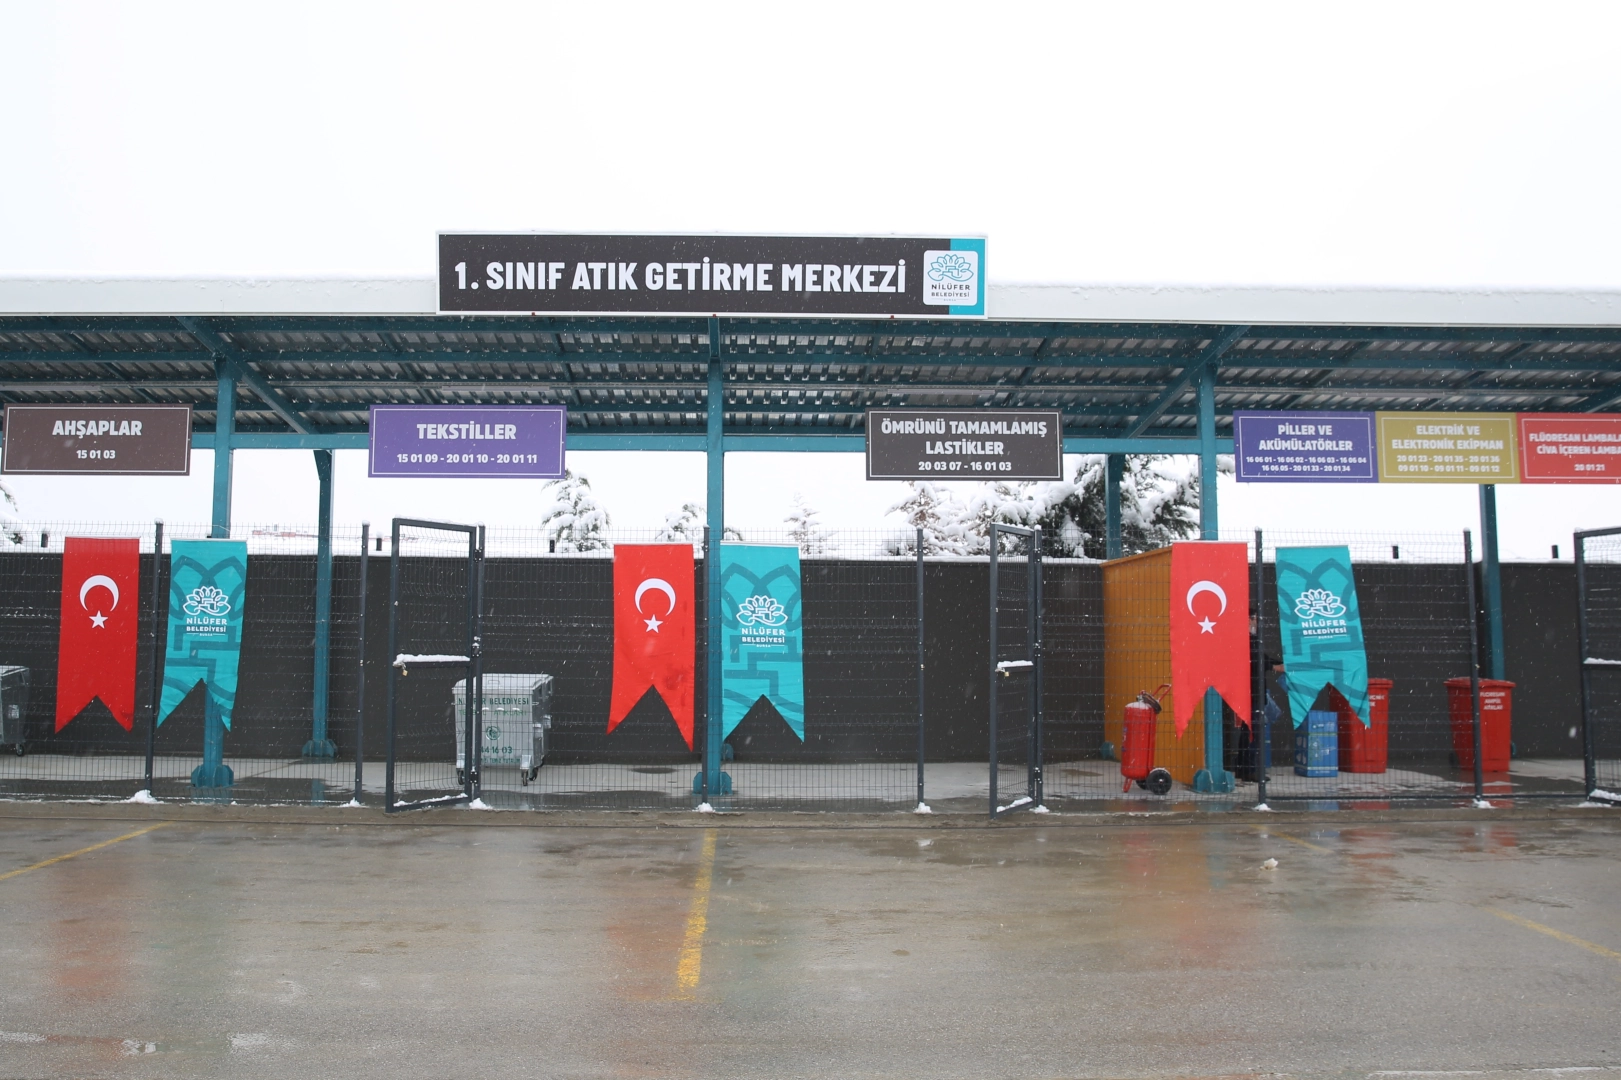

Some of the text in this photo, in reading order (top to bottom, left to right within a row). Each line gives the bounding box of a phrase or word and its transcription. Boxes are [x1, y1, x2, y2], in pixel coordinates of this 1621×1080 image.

[454, 256, 906, 292] 1. SINIF ATIK GETİRME MERKEZİ
[932, 282, 970, 290] NİLÜFER
[52, 420, 142, 438] AHŞAPLAR
[417, 421, 516, 439] TEKSTİLLER
[882, 418, 1047, 437] ÖMRÜNÜ TAMAMLAMIŞ
[1278, 422, 1332, 435] PİLLER VE
[1416, 424, 1480, 435] ELEKTRİK VE
[1529, 432, 1580, 442] FLÜORESAN
[926, 439, 1004, 455] LASTİKLER
[1259, 438, 1353, 451] AKÜMÜLATÖRLER
[1392, 438, 1504, 450] ELEKTRONİK EKİPMAN
[76, 450, 116, 459] 15 01 03
[1536, 444, 1558, 454] CİVA
[1559, 444, 1590, 456] İÇEREN
[397, 454, 408, 463] 15
[411, 454, 422, 463] 01
[426, 454, 438, 463] 09
[447, 454, 459, 463] 20
[462, 454, 474, 463] 01
[476, 454, 488, 463] 10
[497, 454, 509, 463] 20
[512, 454, 524, 463] 01
[527, 454, 537, 463] 11
[918, 461, 931, 471] 20
[934, 461, 946, 471] 03
[949, 461, 961, 471] 07
[970, 461, 982, 471] 16
[984, 461, 996, 471] 01
[999, 461, 1011, 471] 03
[186, 616, 227, 625] NİLÜFER
[1302, 619, 1346, 628] NİLÜFER
[742, 627, 785, 635] NİLÜFER
[1303, 626, 1347, 635] BELEDİYESİ
[502, 746, 512, 754] 03
